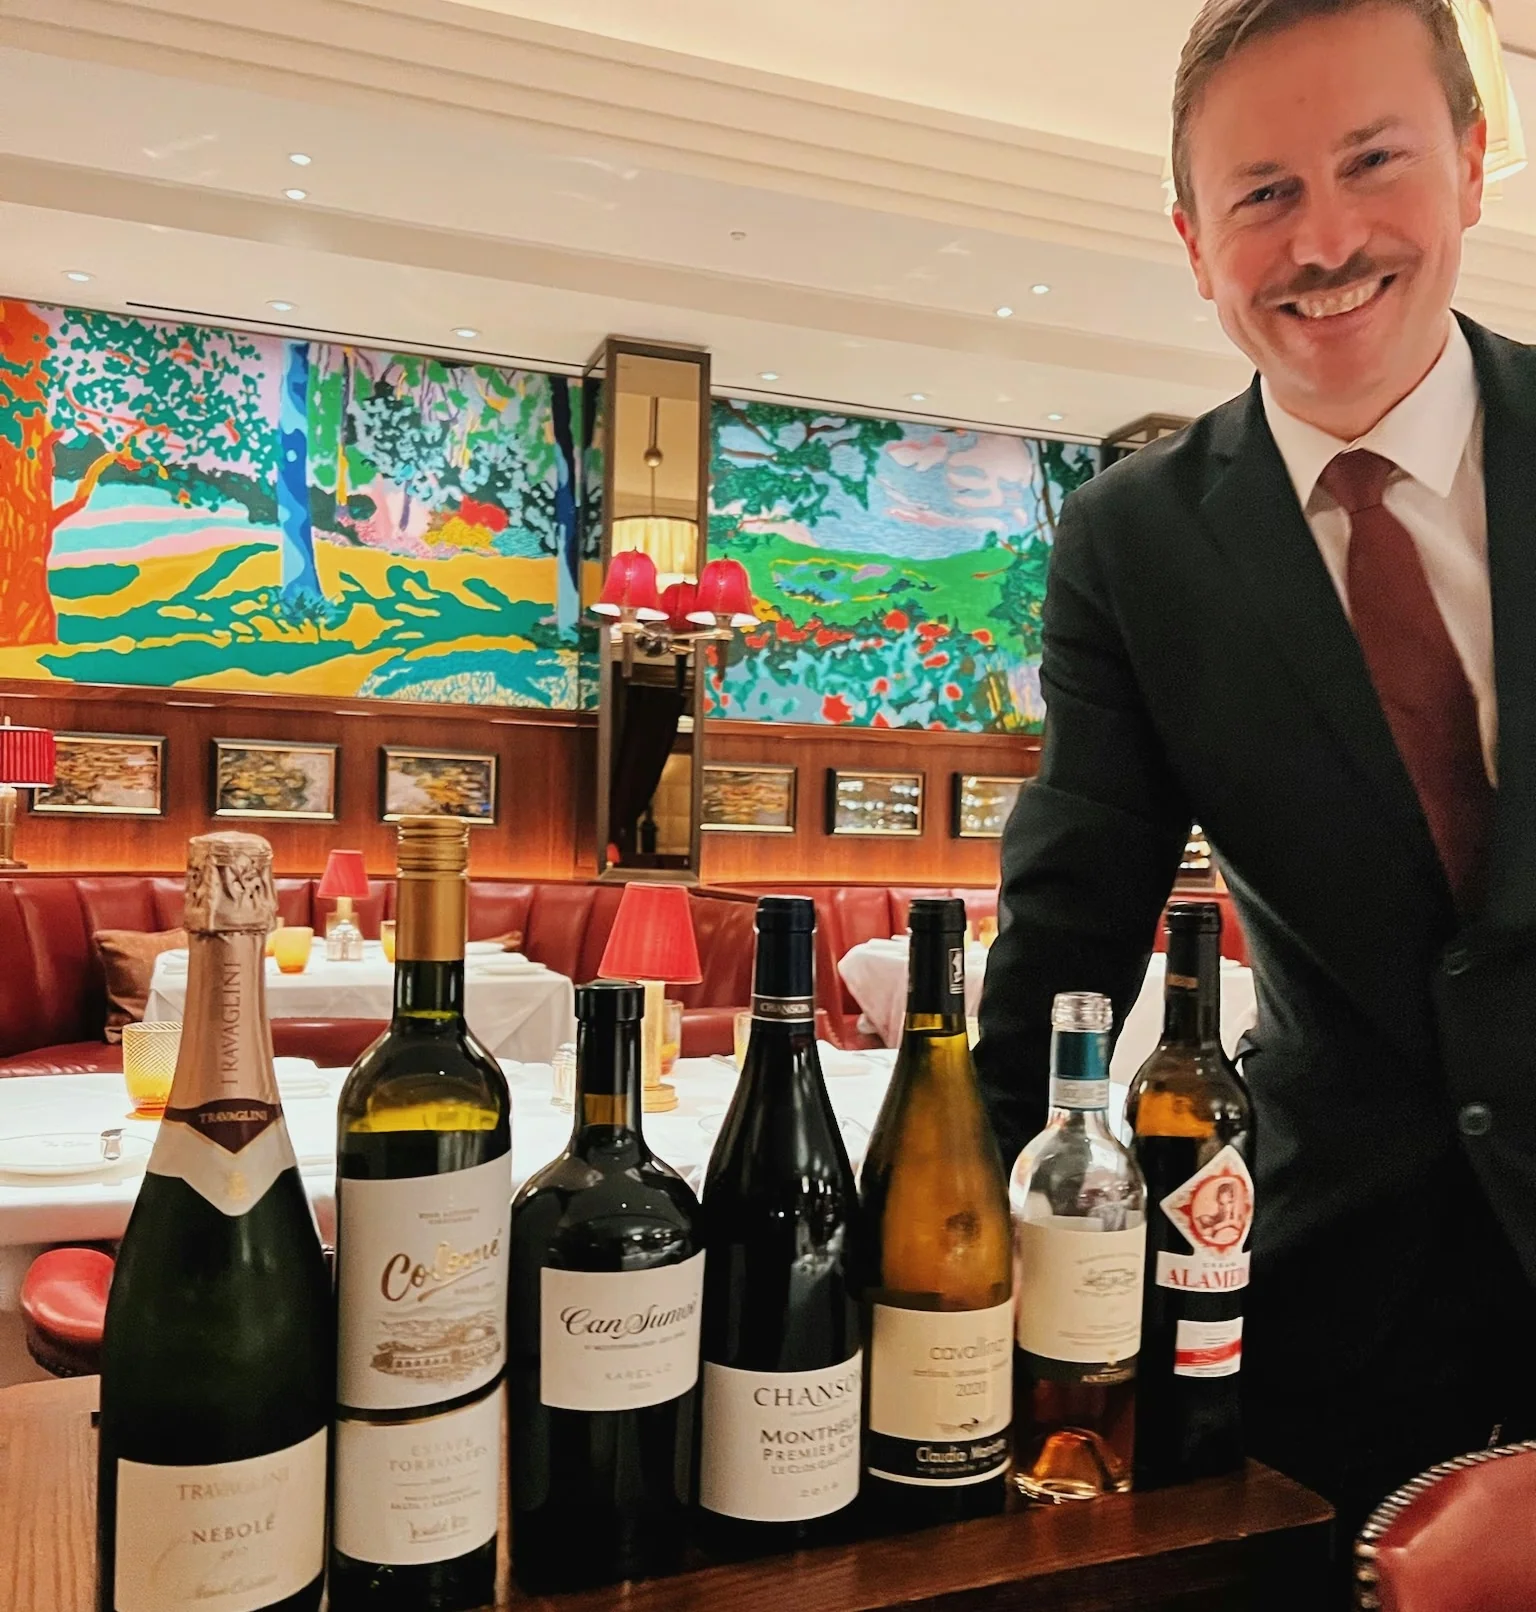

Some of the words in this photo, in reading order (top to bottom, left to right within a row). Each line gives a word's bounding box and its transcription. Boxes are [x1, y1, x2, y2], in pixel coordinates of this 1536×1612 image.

[221, 963, 242, 1085] TRAVAGLINI
[198, 1109, 269, 1124] TRAVAGLINI
[560, 1305, 622, 1340] Can
[753, 1370, 861, 1407] CHANSO
[762, 1442, 836, 1461] PREMIER
[191, 1515, 276, 1546] NEBOLÉ
